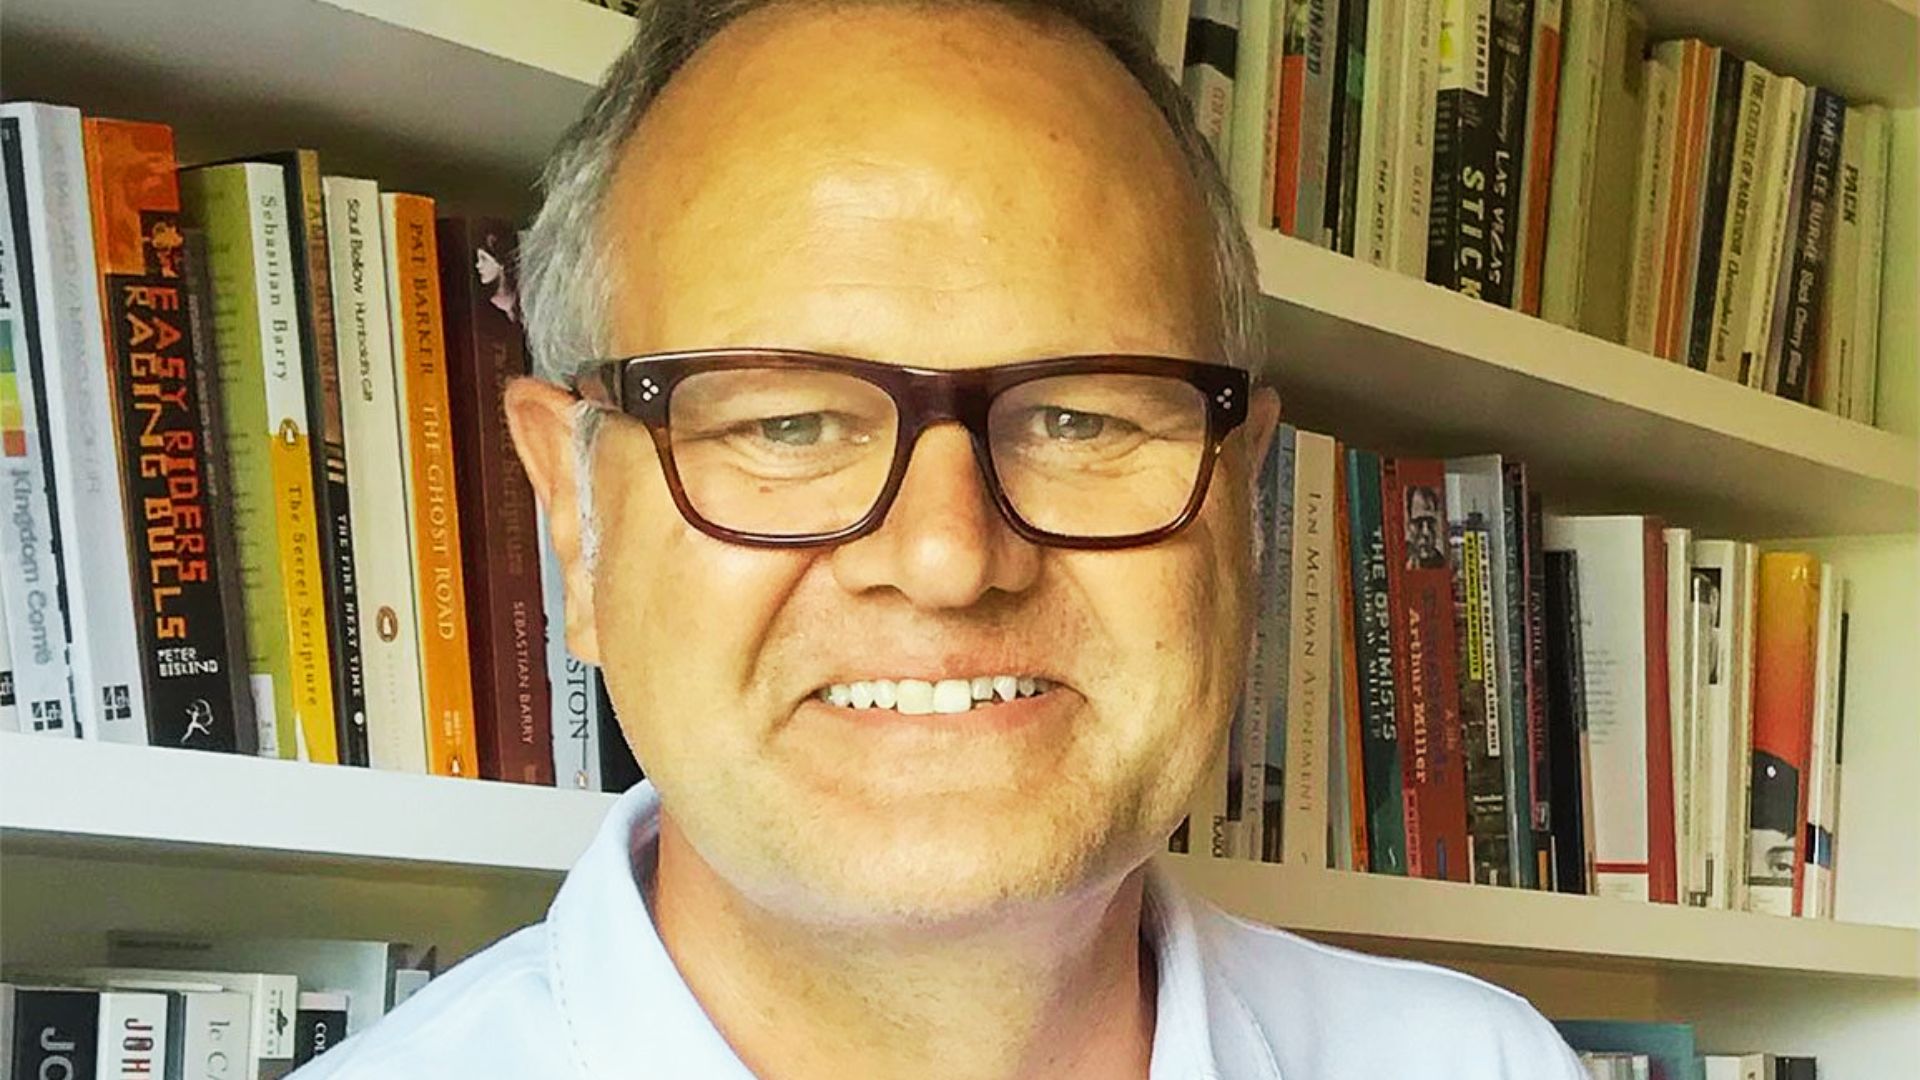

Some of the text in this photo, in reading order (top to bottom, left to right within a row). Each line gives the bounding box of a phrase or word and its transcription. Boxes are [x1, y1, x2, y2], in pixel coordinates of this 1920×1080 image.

[1812, 162, 1831, 197] LEE
[1818, 96, 1840, 158] JAMES
[261, 194, 288, 381] Sebastian Barry
[347, 198, 360, 235] Saul
[349, 238, 364, 295] Bellow
[1460, 165, 1486, 300] STICK
[1803, 201, 1825, 264] BURKE
[149, 286, 188, 411] EASY
[124, 285, 187, 640] RAGING BULLS
[409, 222, 455, 641] PAT BARKER THE GHOST ROAD
[11, 468, 51, 667] Kingdom Come
[163, 430, 208, 582] RIDERS
[157, 647, 197, 662] PETER
[289, 486, 318, 706] The Secret Scripture
[338, 513, 361, 697] THE FIRE NEXT TIME
[1371, 525, 1398, 742] THE OPTIMISTS
[159, 661, 219, 677] BISKIND
[513, 601, 534, 746] SEBASTIAN BARRY
[1408, 607, 1428, 784] Arthur Miller
